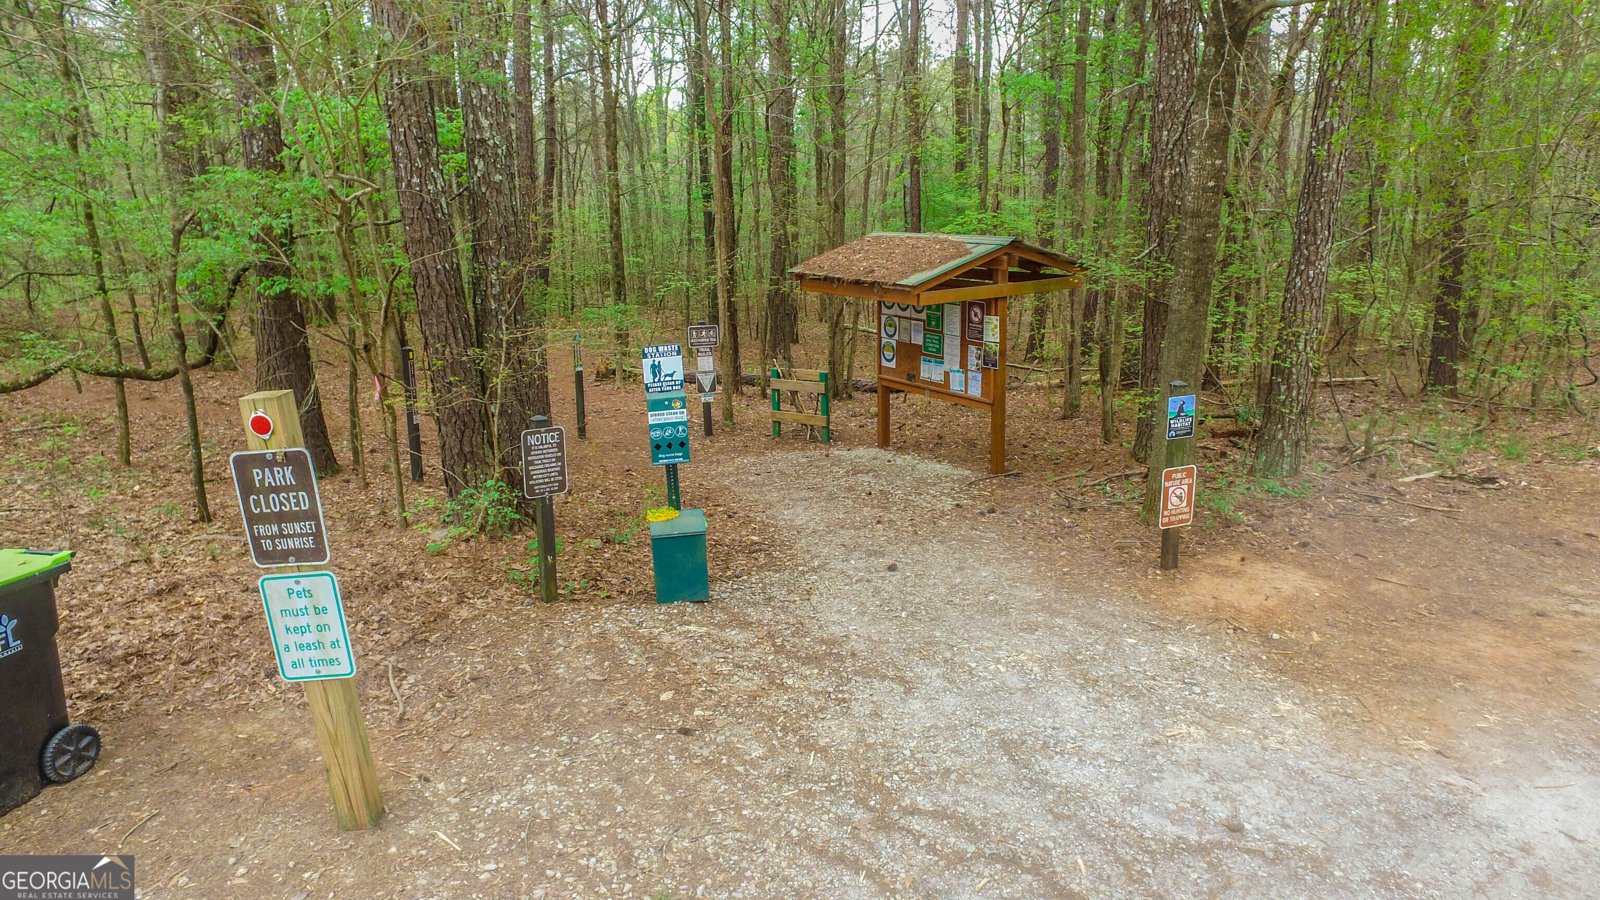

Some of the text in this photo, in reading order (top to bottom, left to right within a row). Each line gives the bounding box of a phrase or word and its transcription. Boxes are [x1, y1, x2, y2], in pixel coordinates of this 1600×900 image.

[528, 432, 560, 446] NOTICE
[253, 466, 296, 487] PARK
[250, 492, 309, 513] CLOSED
[254, 521, 316, 536] FROM SUNSET
[260, 537, 315, 551] TO SUNRISE
[287, 588, 313, 599] Pets
[280, 605, 328, 618] must be
[285, 623, 331, 636] kept on
[284, 638, 341, 652] a leash at
[291, 657, 341, 669] all times
